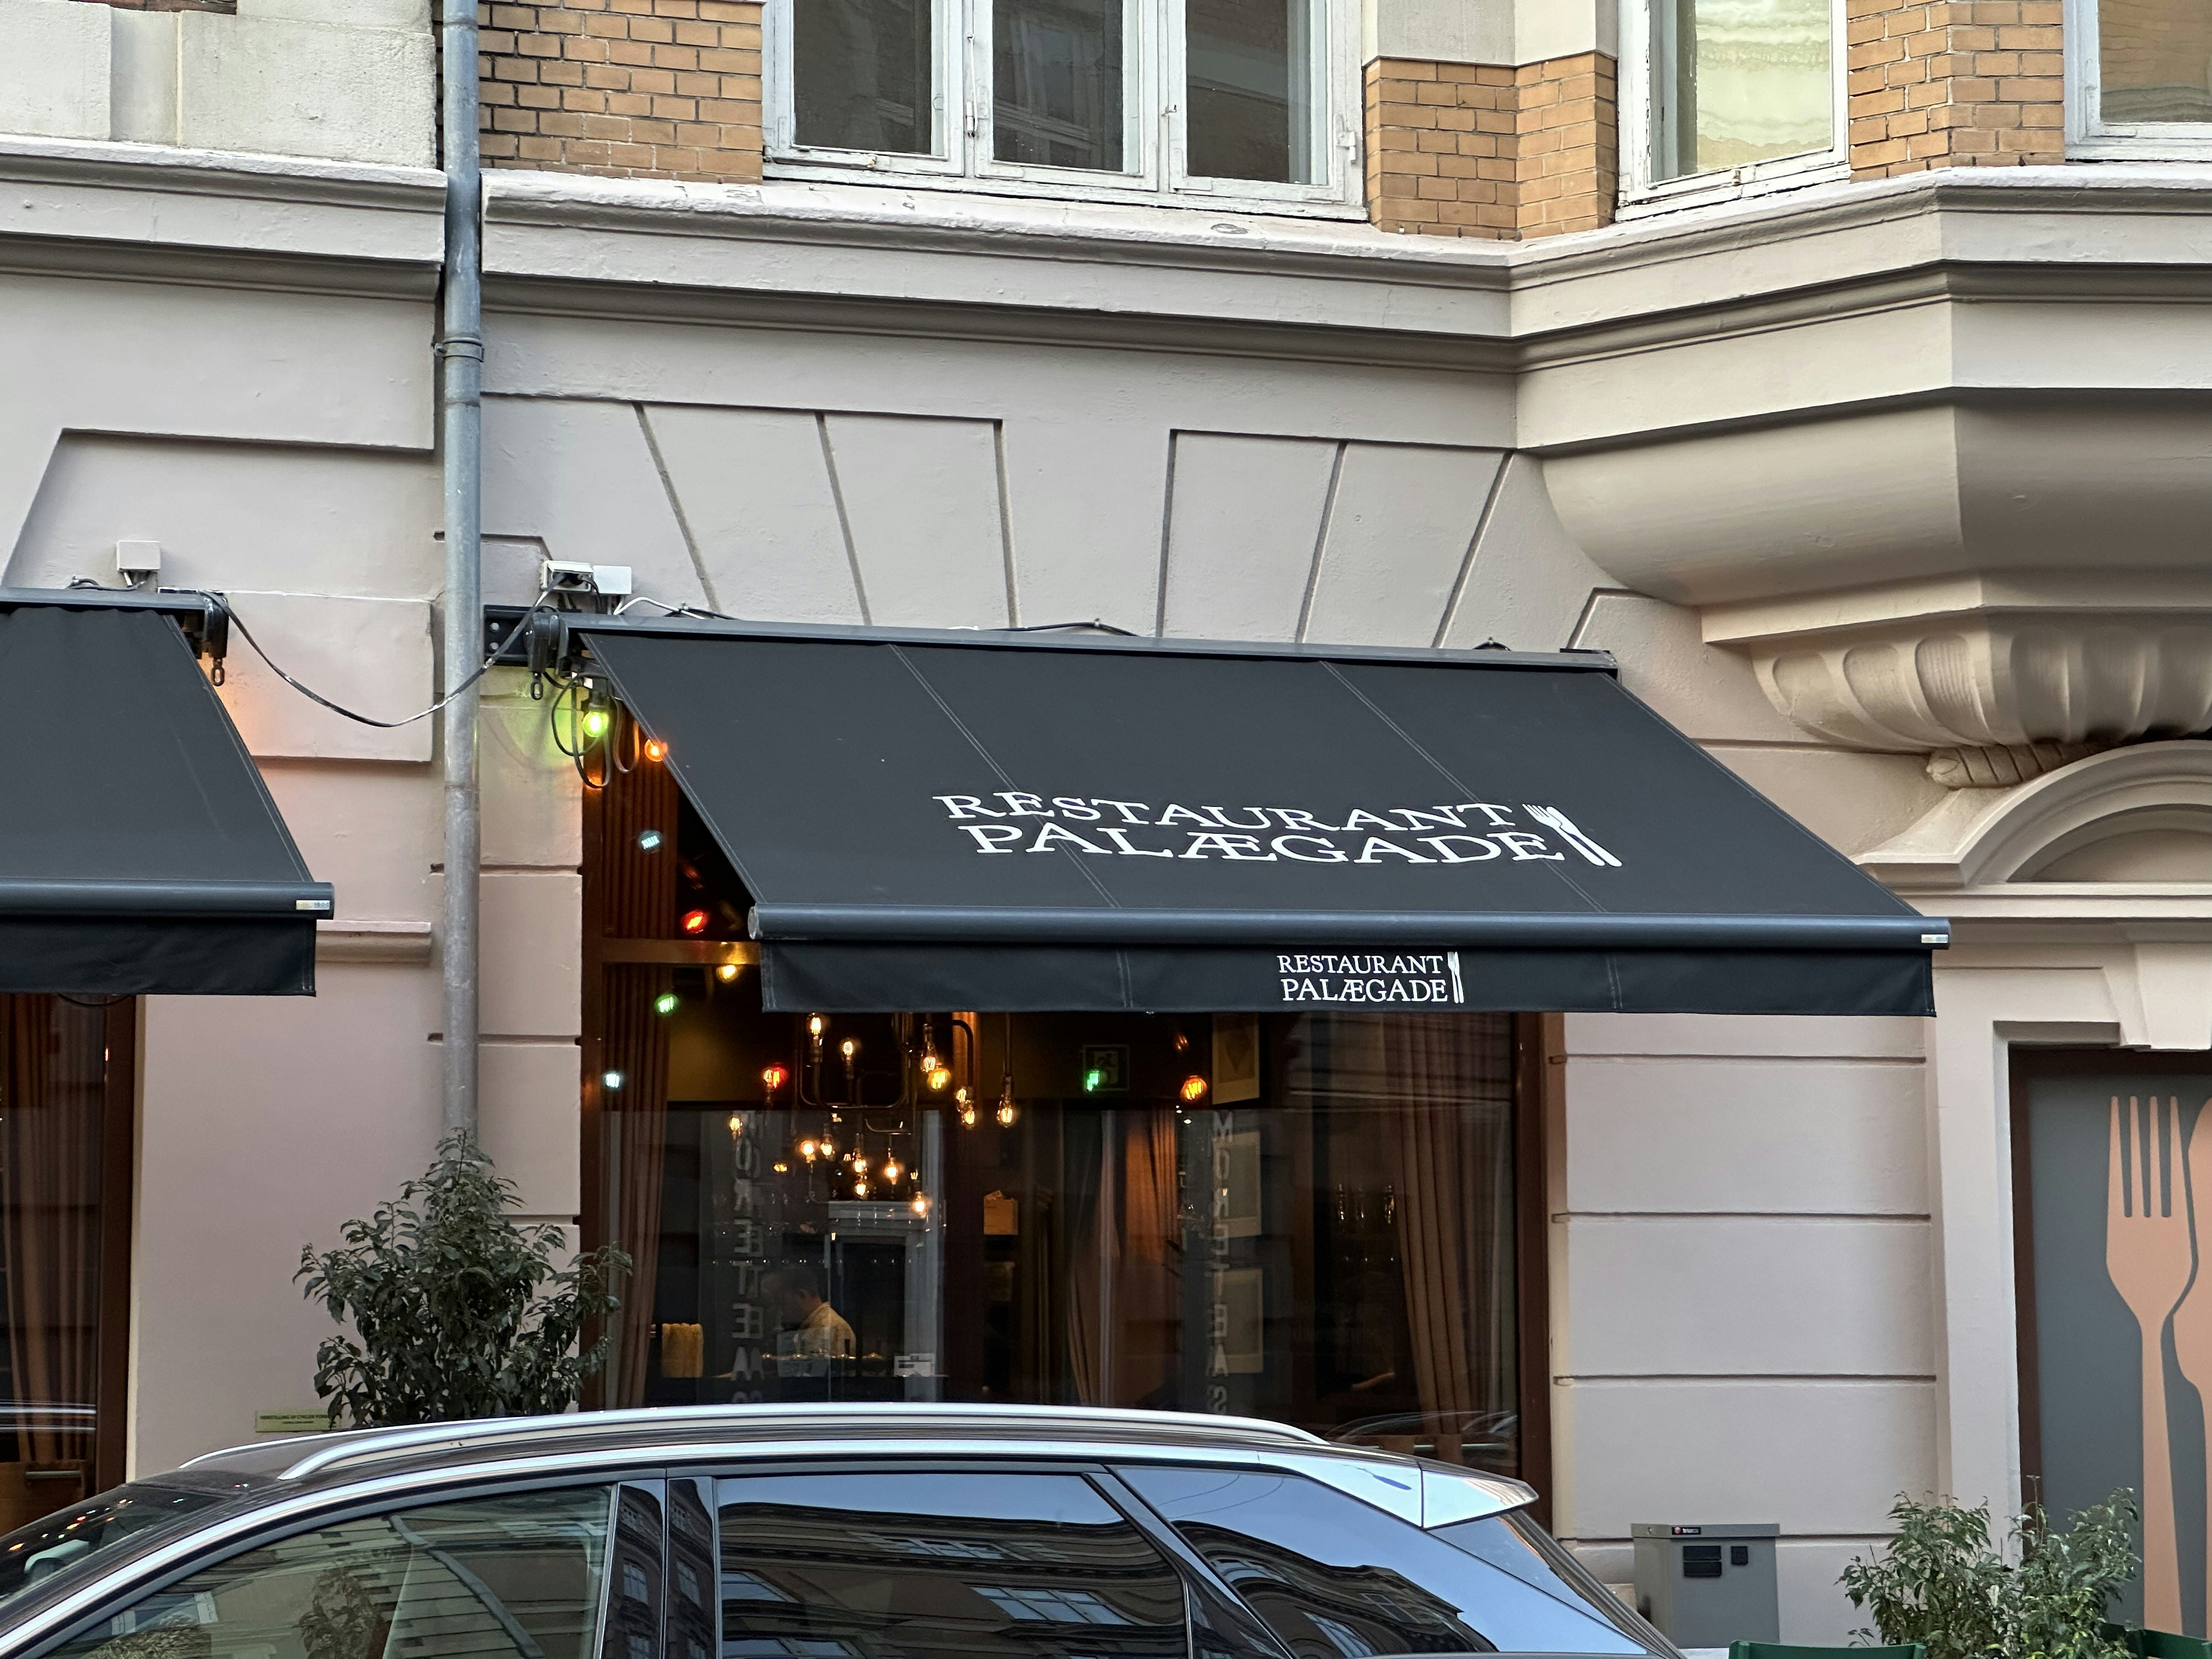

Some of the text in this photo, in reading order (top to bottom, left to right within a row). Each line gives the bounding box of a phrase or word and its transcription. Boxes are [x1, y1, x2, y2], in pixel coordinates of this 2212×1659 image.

[932, 791, 1516, 831] RESTAURANT
[957, 822, 1565, 864] PALÆGADE
[1277, 955, 1443, 974] RESTAURANT
[1280, 978, 1448, 1002] PALÆGADE
